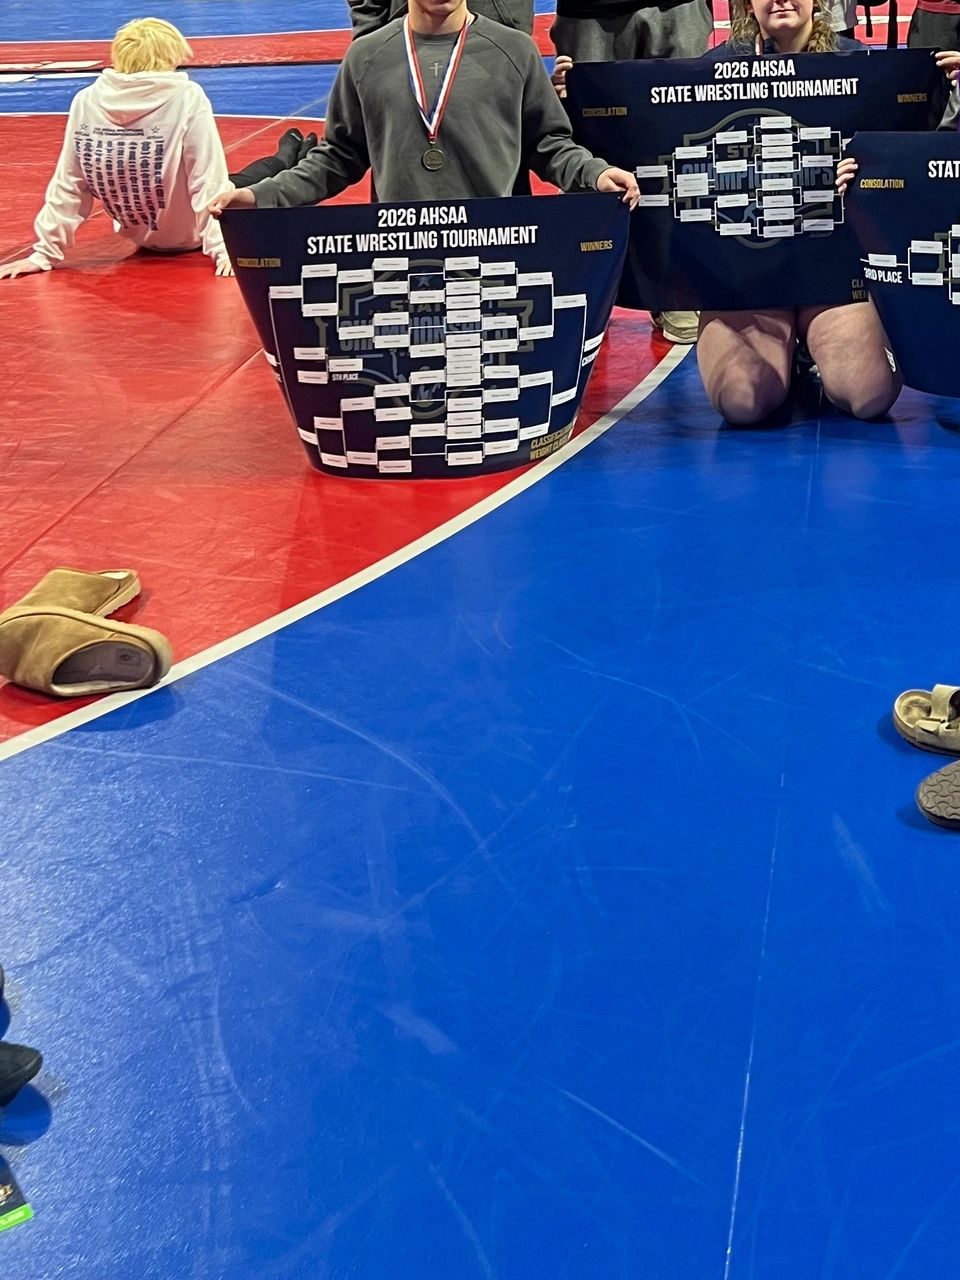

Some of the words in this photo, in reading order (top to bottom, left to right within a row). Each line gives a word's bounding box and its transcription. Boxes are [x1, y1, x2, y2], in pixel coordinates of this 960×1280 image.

[714, 61, 749, 80] 2026
[751, 59, 796, 78] AHSAA
[650, 84, 693, 104] STATE
[695, 81, 769, 102] WRESTLING
[772, 78, 859, 100] TOURNAMENT
[897, 92, 928, 104] WINNERS
[859, 178, 904, 189] CONSOLATION
[377, 208, 416, 228] 2026
[419, 205, 468, 226] AHSAA
[307, 235, 353, 255] STATE
[356, 230, 438, 253] WRESTLING
[441, 225, 539, 249] TOURNAMENT
[580, 240, 613, 252] WINNERS
[877, 269, 903, 284] PLACE
[331, 373, 342, 381] 5TH
[342, 372, 360, 381] PLACE
